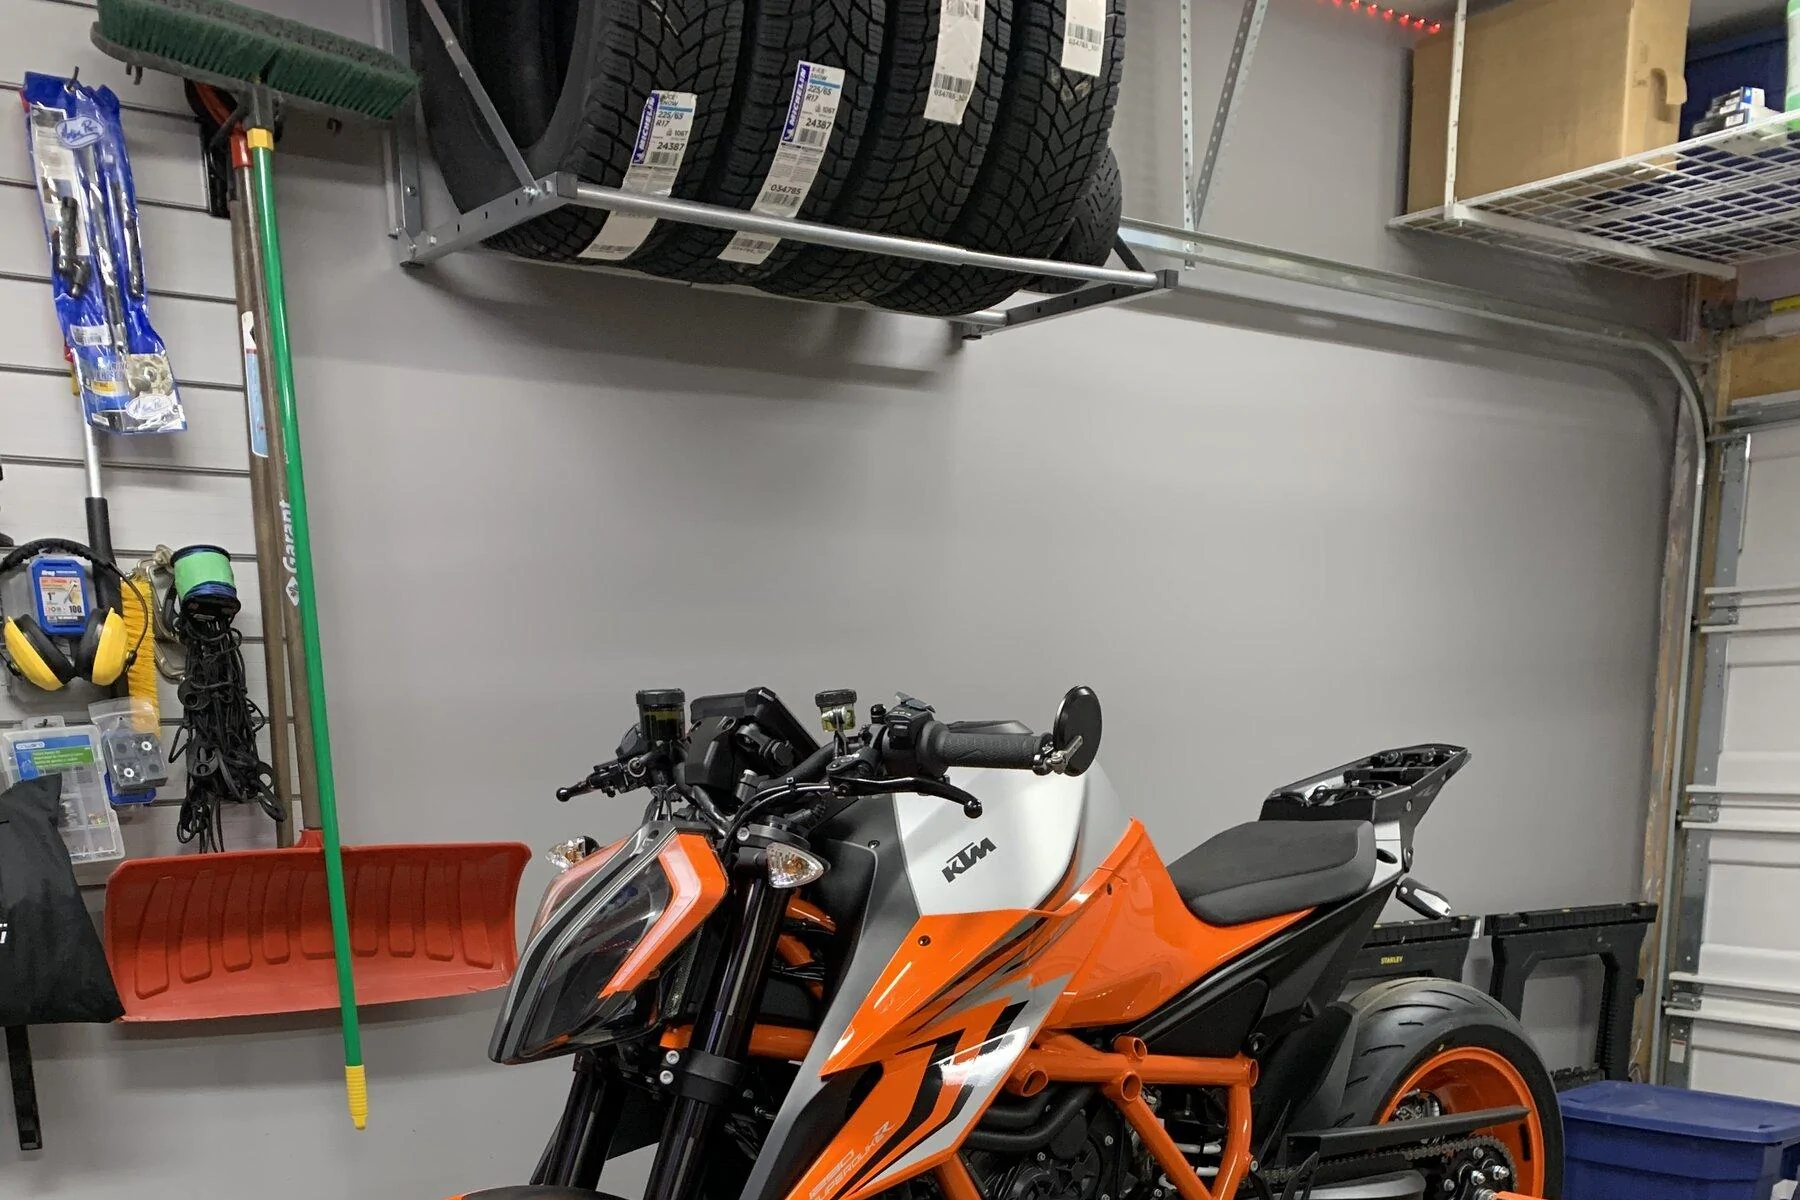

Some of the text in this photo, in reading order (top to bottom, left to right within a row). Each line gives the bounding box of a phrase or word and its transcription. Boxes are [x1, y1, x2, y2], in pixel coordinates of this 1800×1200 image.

[807, 84, 832, 96] 225/65
[789, 68, 807, 126] MICHELIN
[805, 94, 819, 103] R17
[657, 110, 684, 120] 225/65
[638, 96, 656, 150] MICHELIN
[655, 119, 671, 127] R17
[805, 117, 833, 131] 24387
[656, 141, 685, 151] 24387
[770, 183, 803, 196] 034785
[280, 499, 298, 574] Garant
[69, 605, 83, 614] 100
[942, 837, 997, 883] KTM
[1380, 955, 1404, 965] STANLEY
